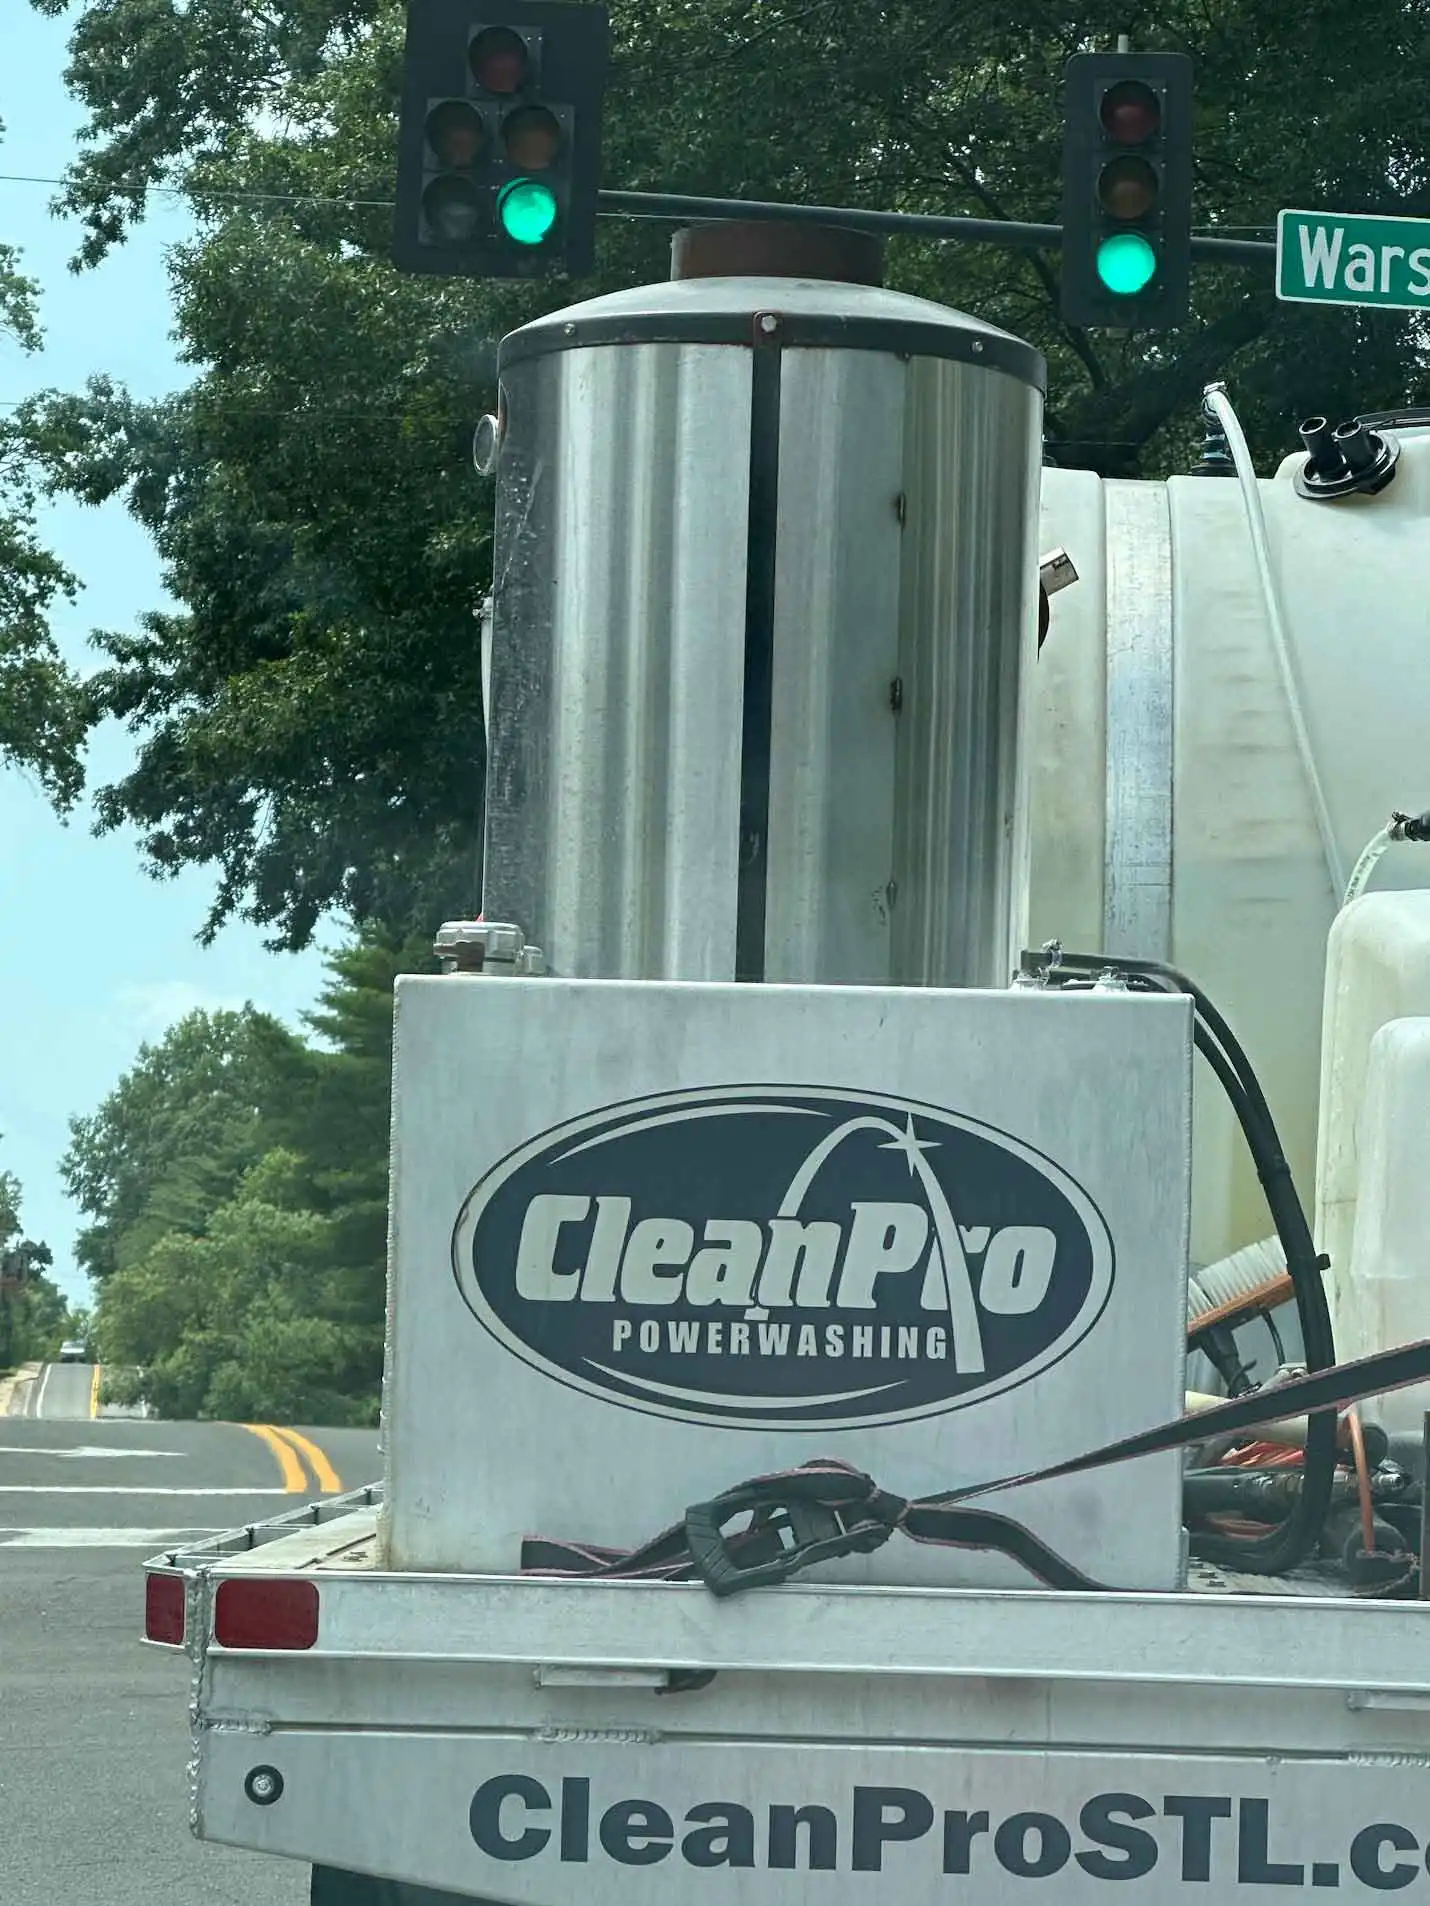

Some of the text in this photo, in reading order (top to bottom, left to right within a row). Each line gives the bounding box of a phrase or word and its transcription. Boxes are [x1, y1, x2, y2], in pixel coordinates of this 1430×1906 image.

[515, 1194, 1057, 1315] CleanPro
[612, 1319, 948, 1360] POWERWASHING
[469, 1774, 1430, 1890] CleanProSTL.c
